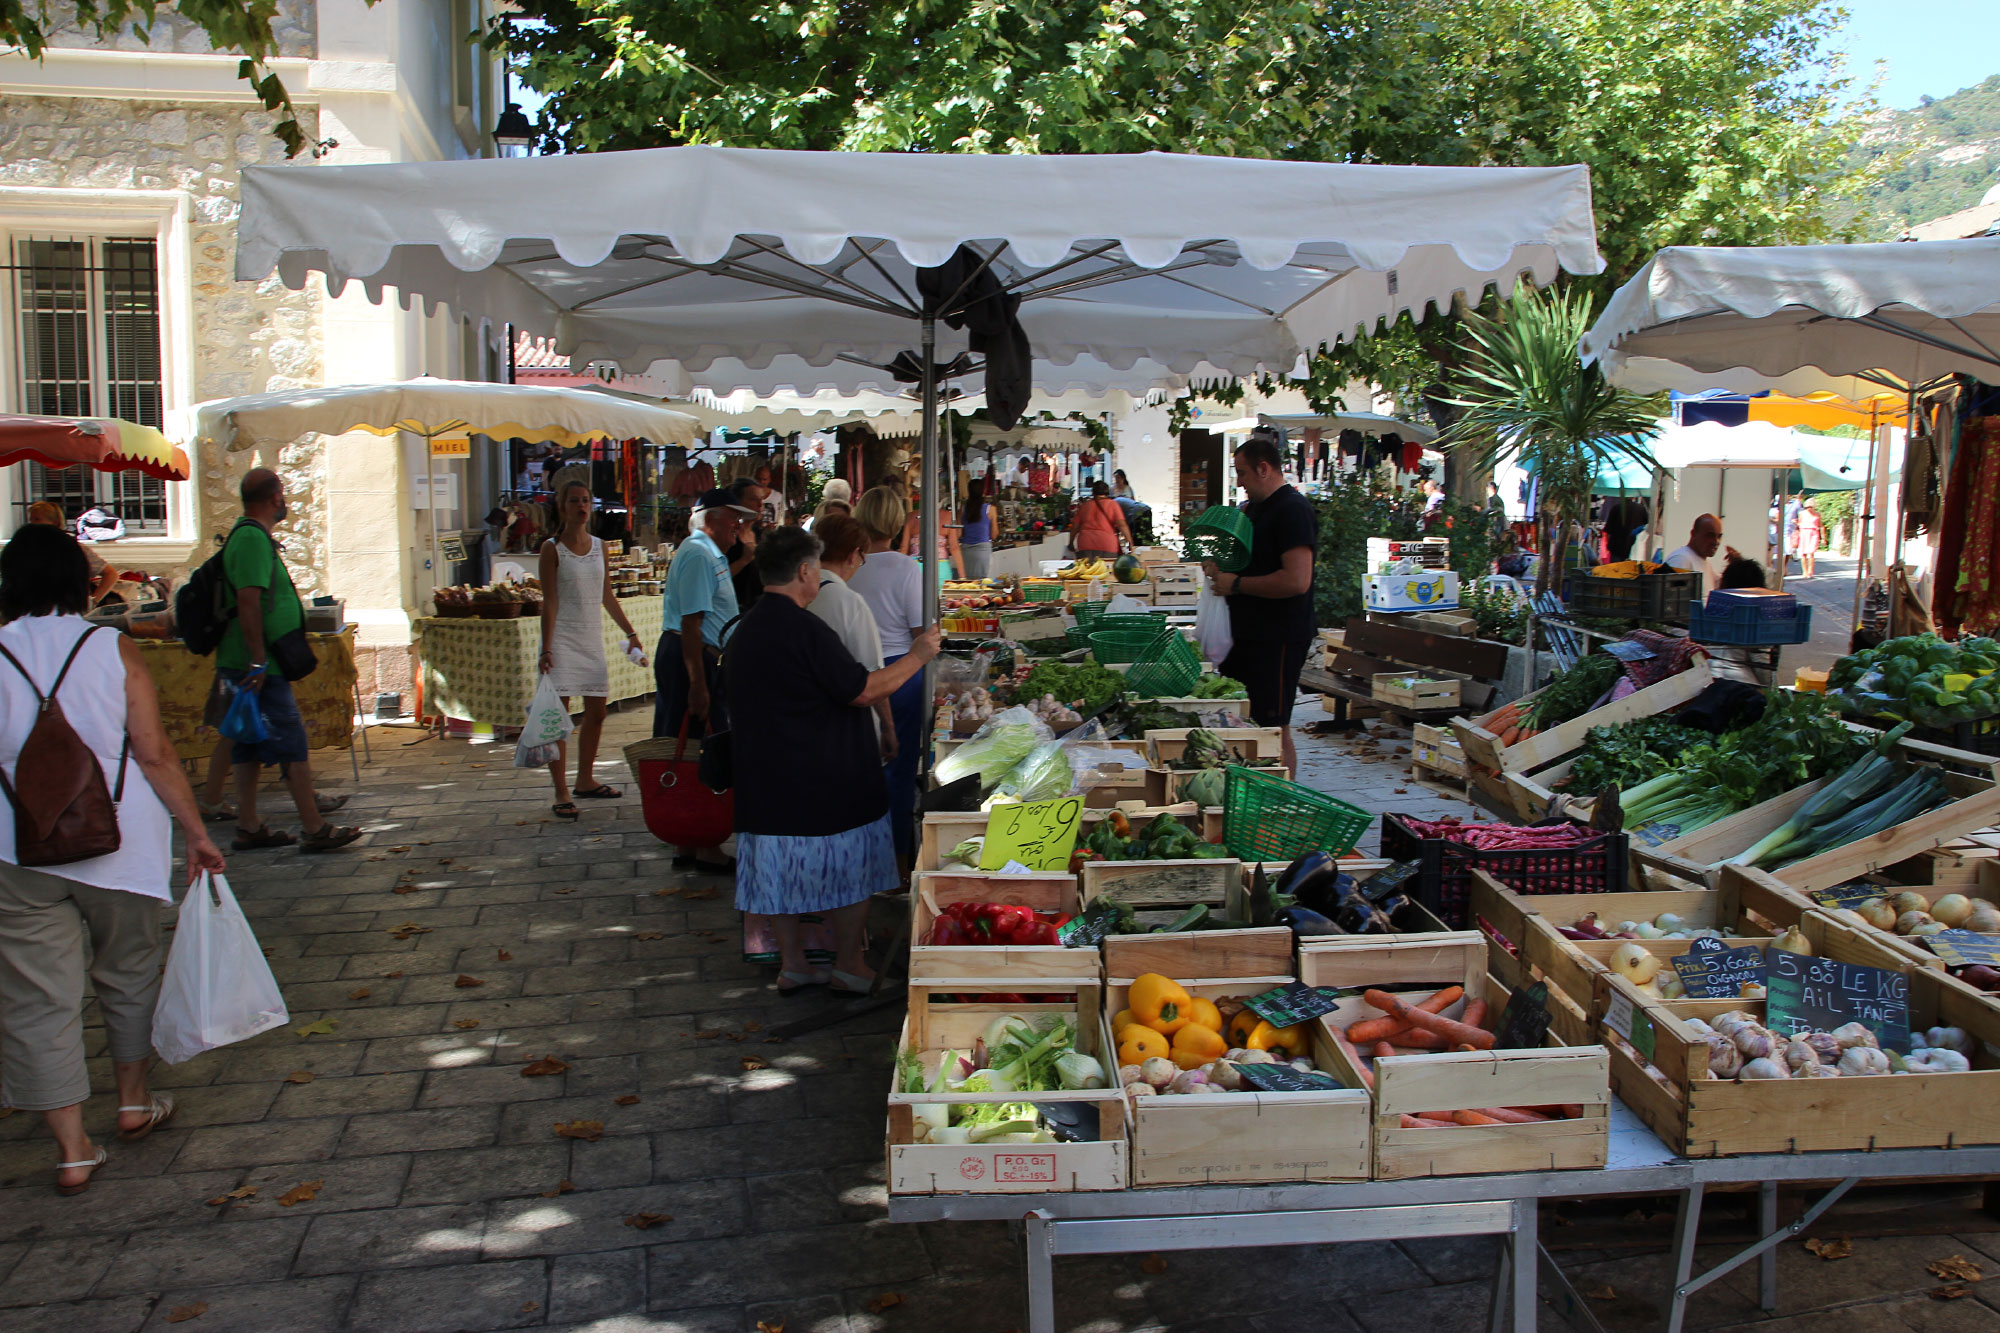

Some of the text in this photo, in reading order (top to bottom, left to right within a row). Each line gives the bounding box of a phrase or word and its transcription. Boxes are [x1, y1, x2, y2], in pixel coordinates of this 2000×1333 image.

[433, 443, 467, 453] MIEL
[1842, 965, 1868, 993] LE
[1876, 970, 1908, 999] KG
